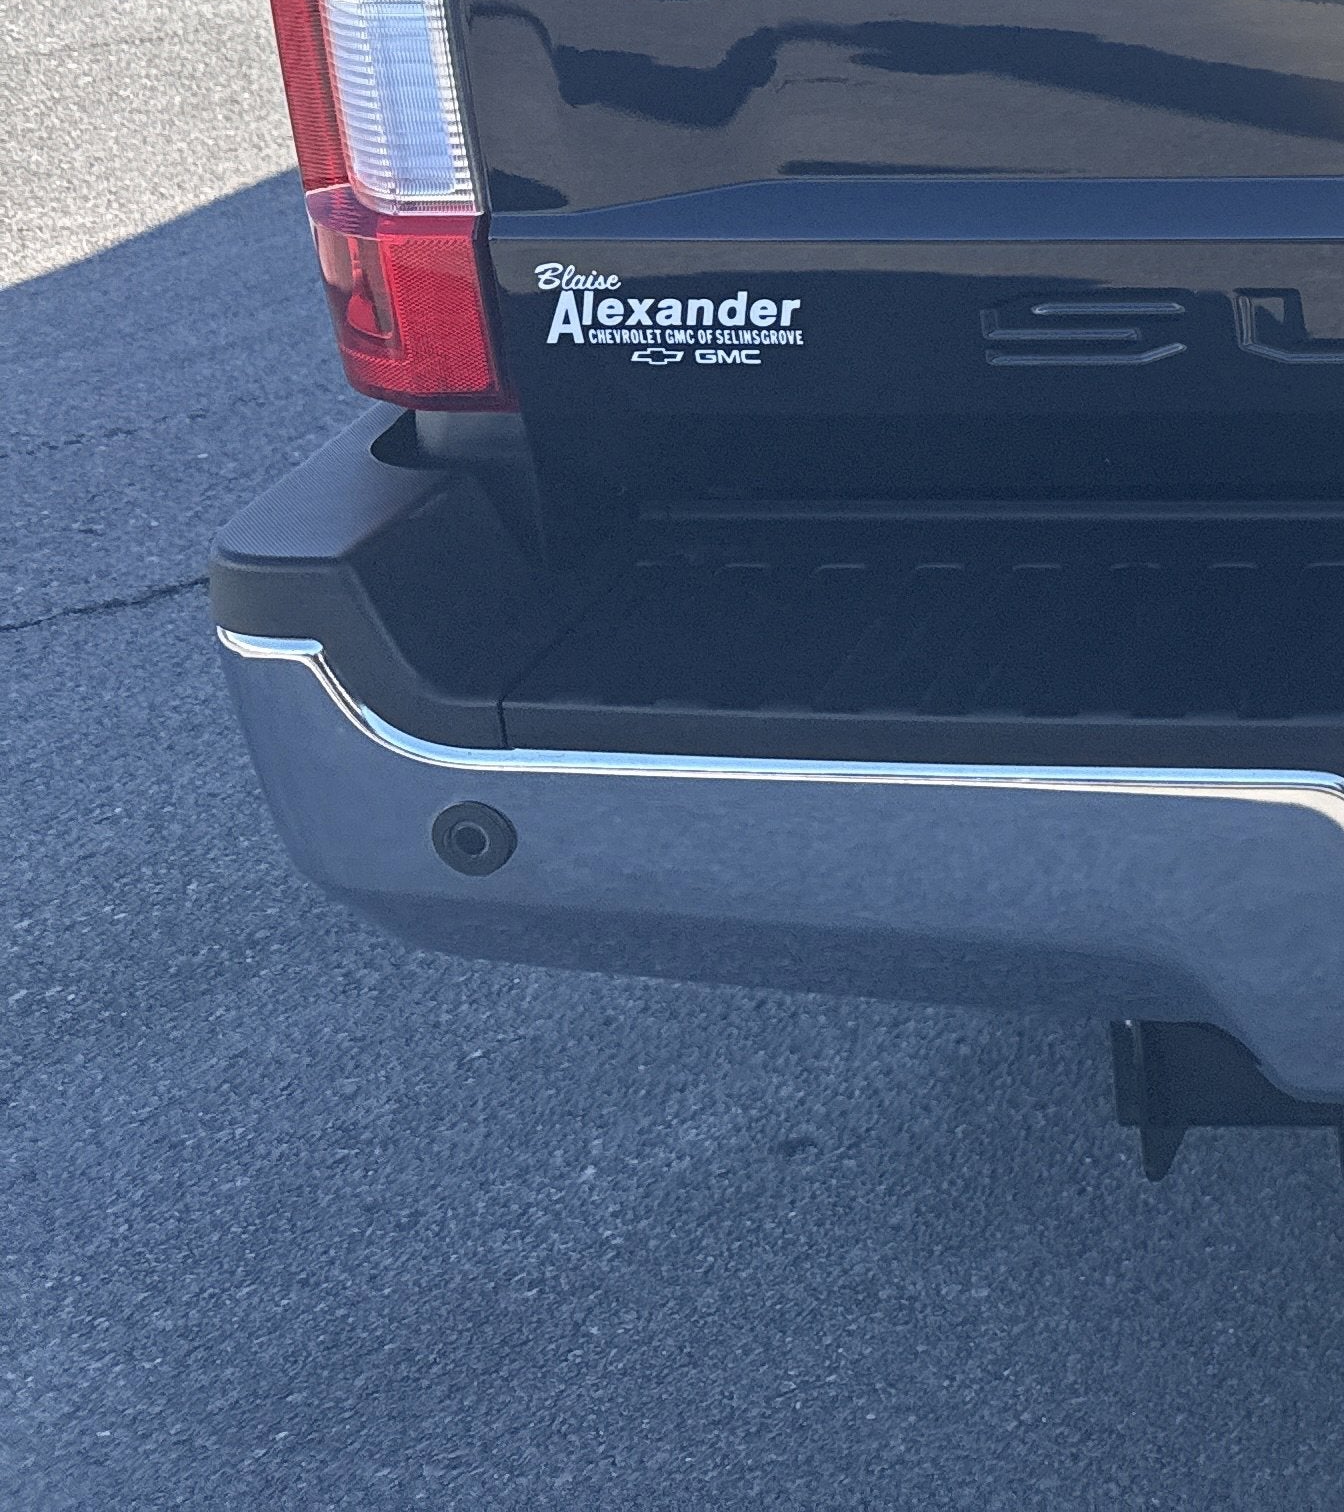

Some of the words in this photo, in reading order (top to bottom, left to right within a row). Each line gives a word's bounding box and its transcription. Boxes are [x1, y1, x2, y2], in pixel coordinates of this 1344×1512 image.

[534, 262, 622, 290] Blaise
[546, 290, 801, 344] Alexander
[588, 329, 662, 344] CHEVROLET
[665, 329, 695, 344] GMC
[697, 329, 713, 344] OF
[715, 329, 804, 345] SELINSGROVE
[694, 349, 762, 364] GMC
